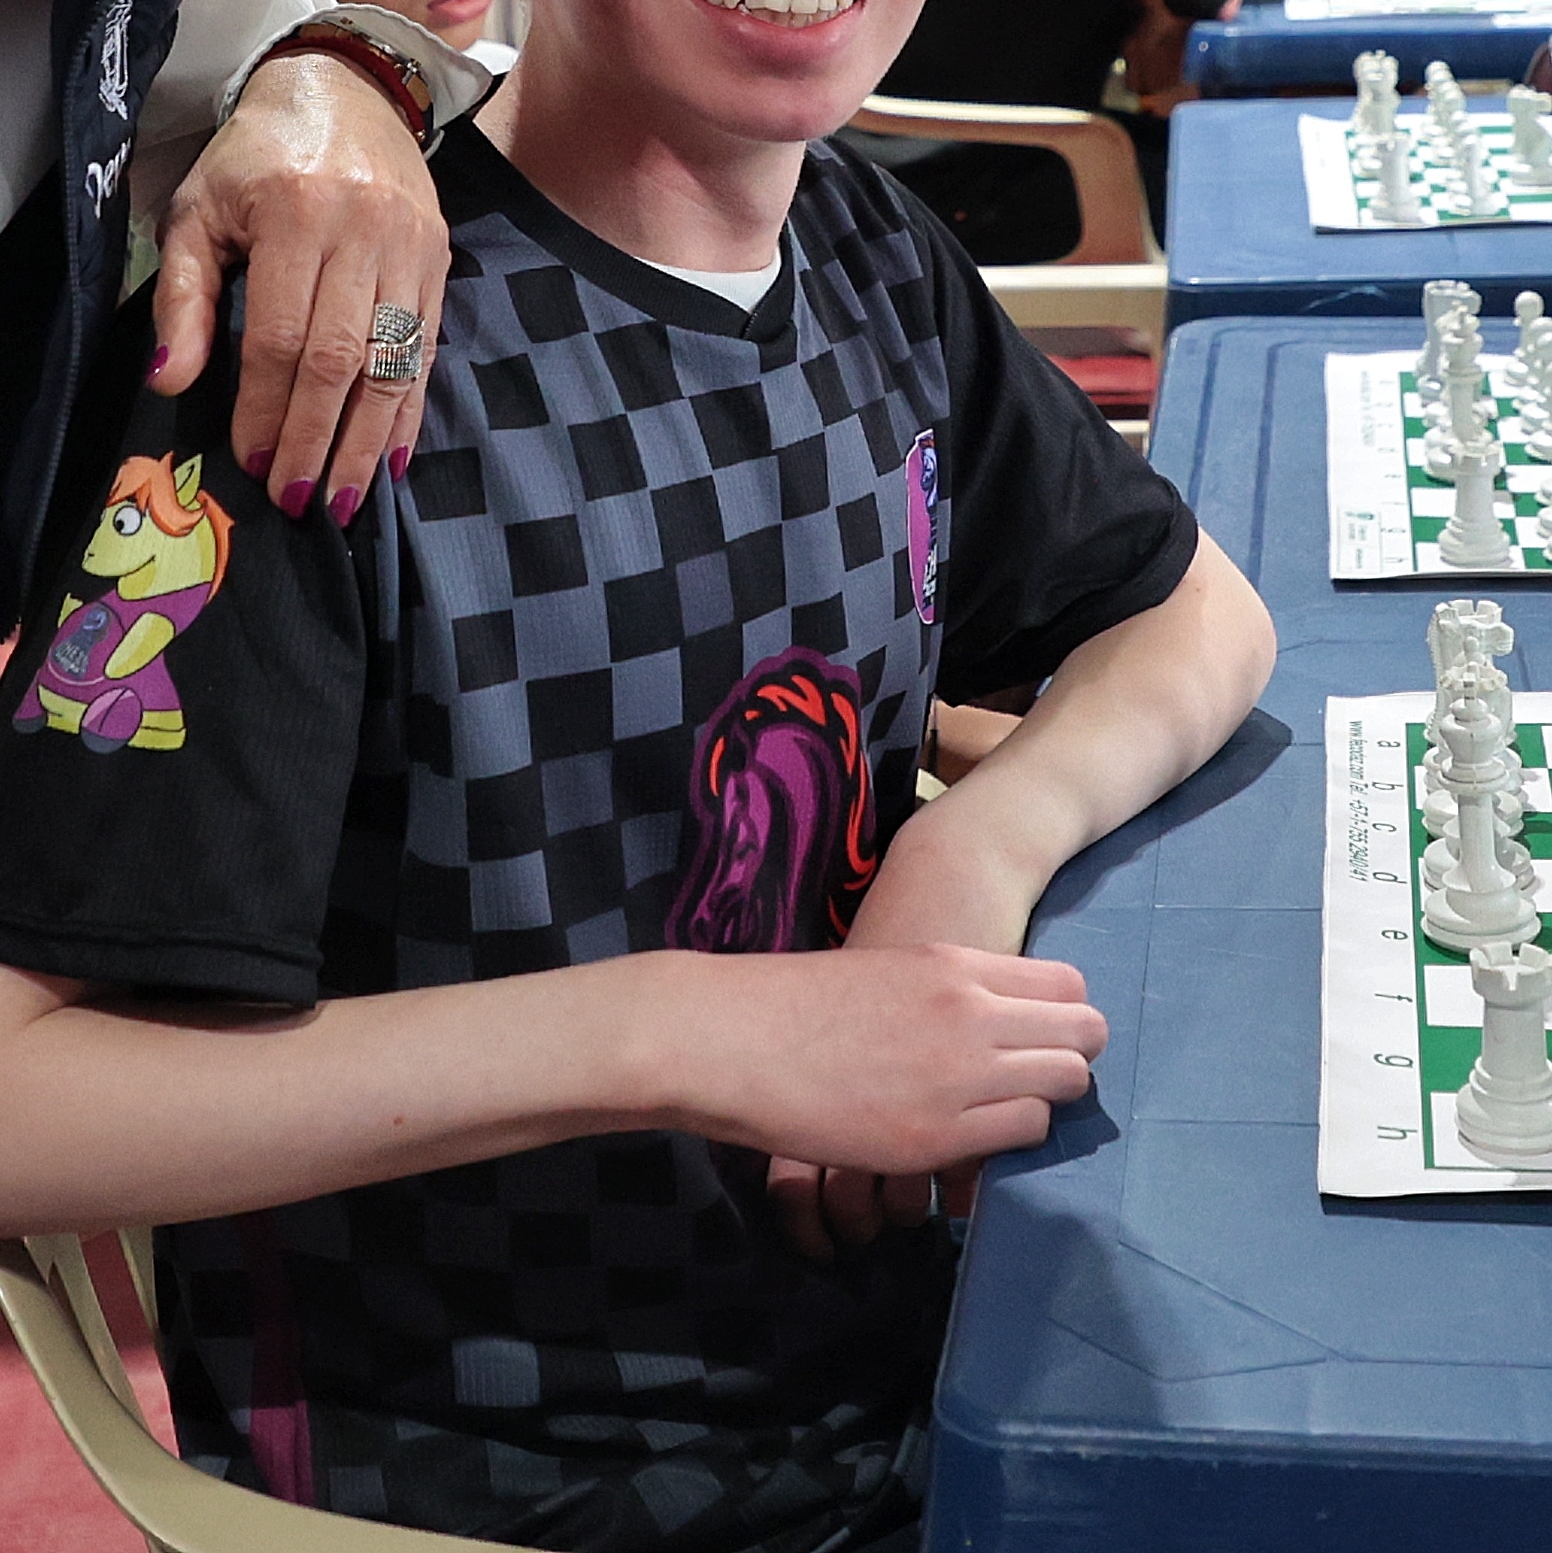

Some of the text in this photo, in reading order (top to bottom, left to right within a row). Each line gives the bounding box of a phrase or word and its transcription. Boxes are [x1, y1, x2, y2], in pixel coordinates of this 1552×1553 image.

[1377, 740, 1401, 748] a
[1371, 781, 1405, 791] b
[1371, 822, 1397, 833] c
[1372, 871, 1408, 884] d
[1381, 929, 1409, 941] e
[1374, 993, 1413, 1003] f
[1373, 1053, 1414, 1069] g
[1376, 1125, 1418, 1141] h
